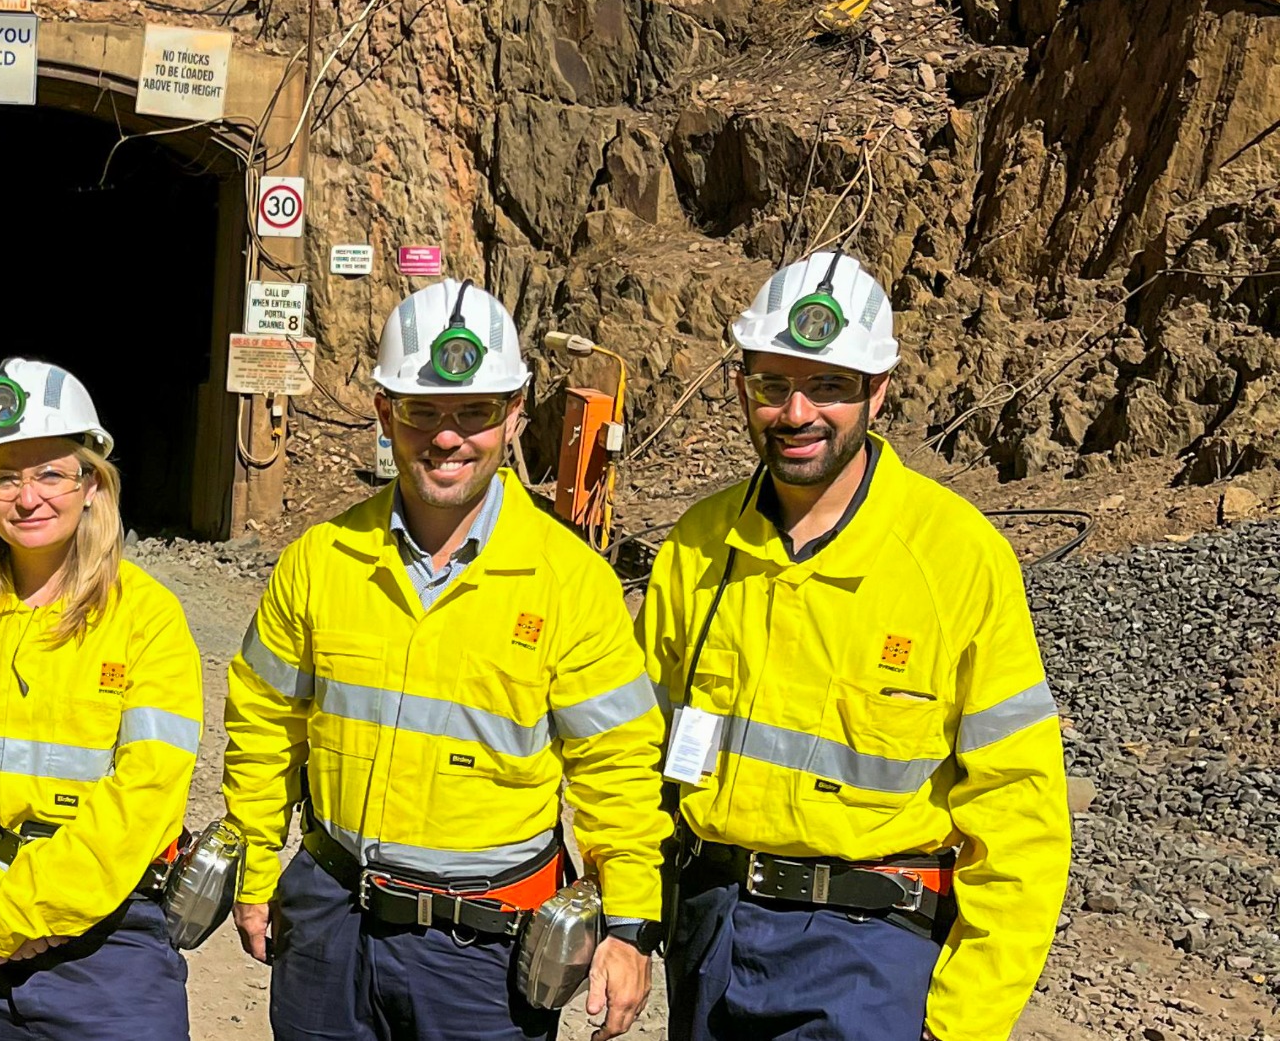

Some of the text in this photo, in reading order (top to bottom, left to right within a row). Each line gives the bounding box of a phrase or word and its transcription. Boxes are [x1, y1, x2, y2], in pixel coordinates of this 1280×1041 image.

[163, 50, 209, 65] NO TRUCKS
[155, 64, 214, 82] TO BE LOADED
[143, 78, 222, 98] ABOVE TUB HEIGHT
[267, 196, 296, 217] 30
[265, 288, 290, 298] CALL UP
[252, 299, 302, 309] WHEN ENTERING
[264, 310, 287, 319] PORTAL
[258, 316, 299, 330] CHANNEL 8
